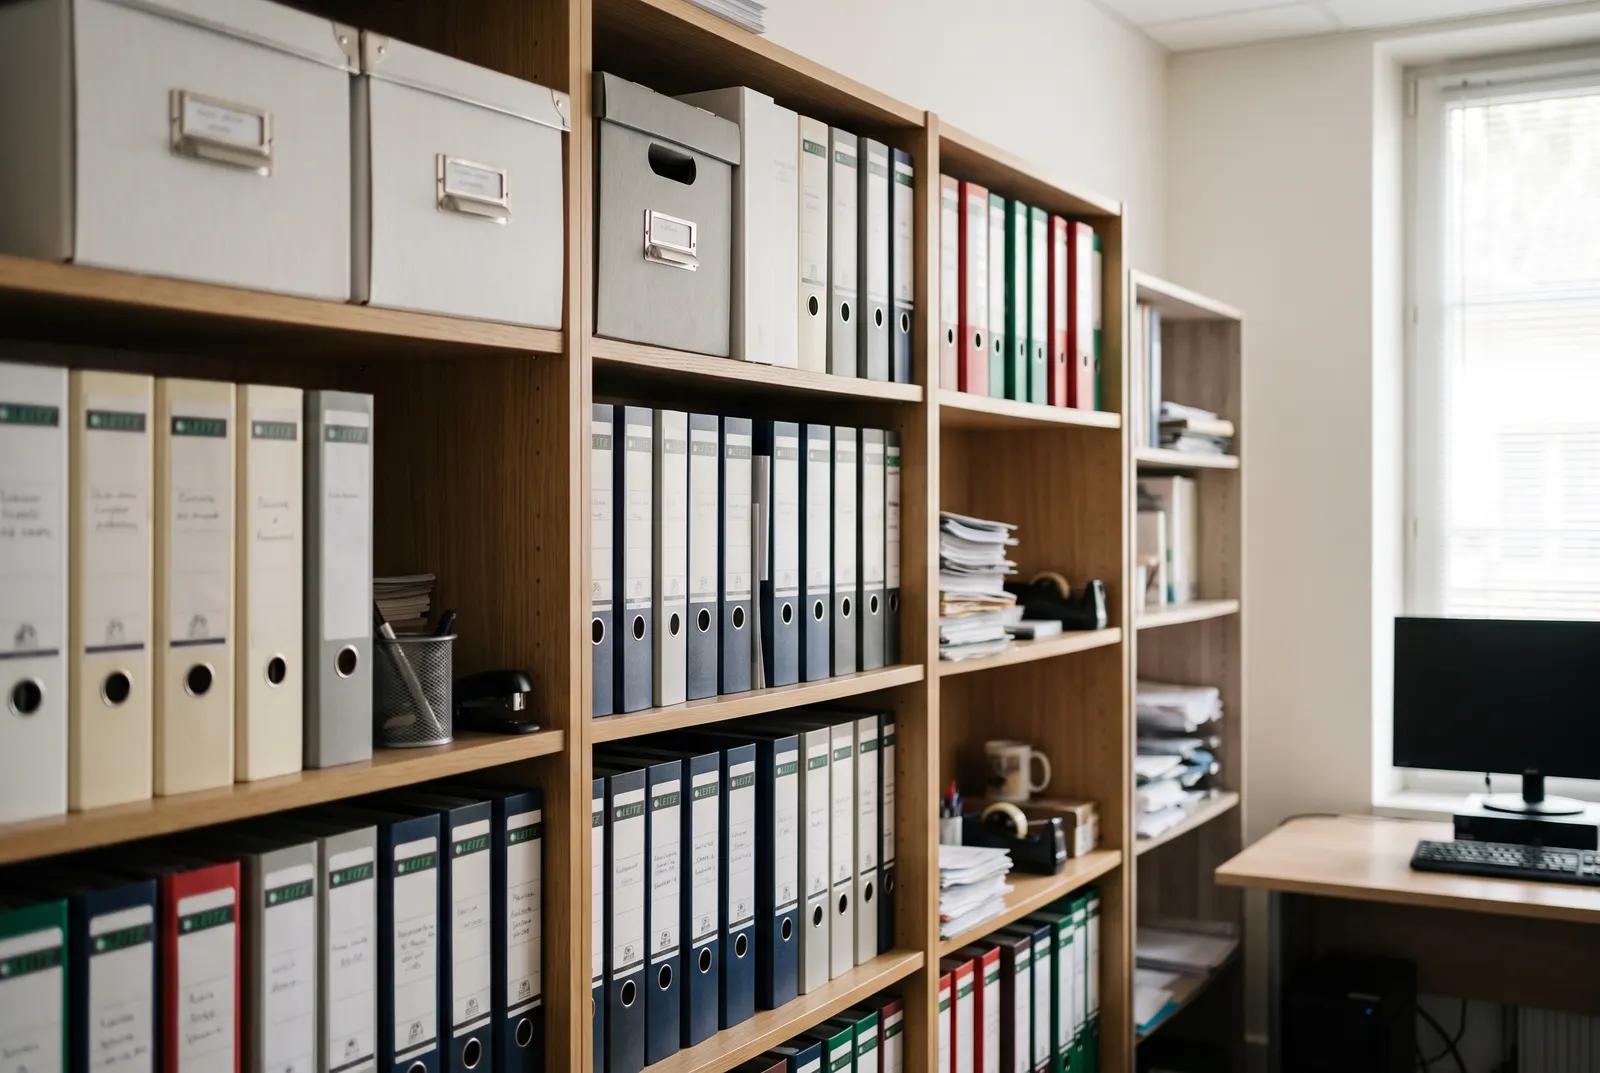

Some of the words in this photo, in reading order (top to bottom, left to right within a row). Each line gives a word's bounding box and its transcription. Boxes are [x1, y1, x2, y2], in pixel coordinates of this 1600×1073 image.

[736, 775, 753, 787] LEITZ
[699, 785, 716, 797] LEITZ
[660, 795, 677, 807] LEITZ
[622, 804, 642, 816] LEITZ
[516, 828, 537, 841] LEITZ
[462, 837, 486, 852] LEITZ
[405, 856, 432, 871] LEITZ
[341, 866, 369, 882] LEITZ
[277, 884, 308, 899] LEITZ
